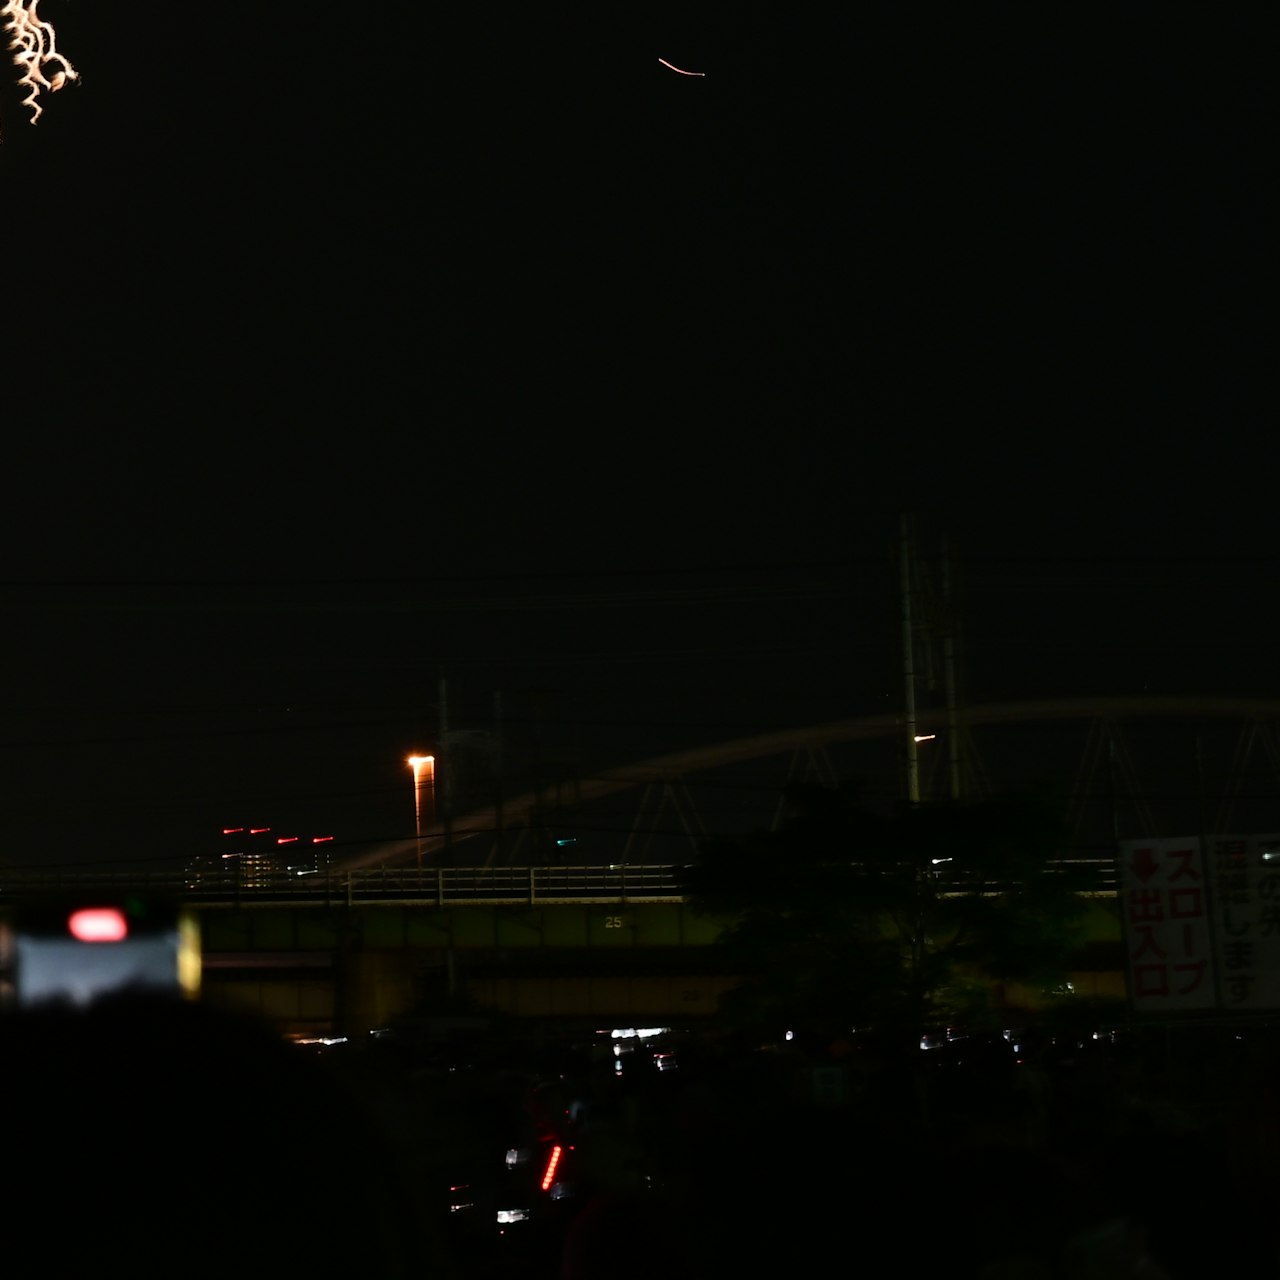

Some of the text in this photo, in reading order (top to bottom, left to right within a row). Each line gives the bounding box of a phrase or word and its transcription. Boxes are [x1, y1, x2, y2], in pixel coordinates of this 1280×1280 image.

[605, 916, 622, 928] 25
[1128, 888, 1169, 998] 出入口
[1166, 849, 1208, 995] スロープ
